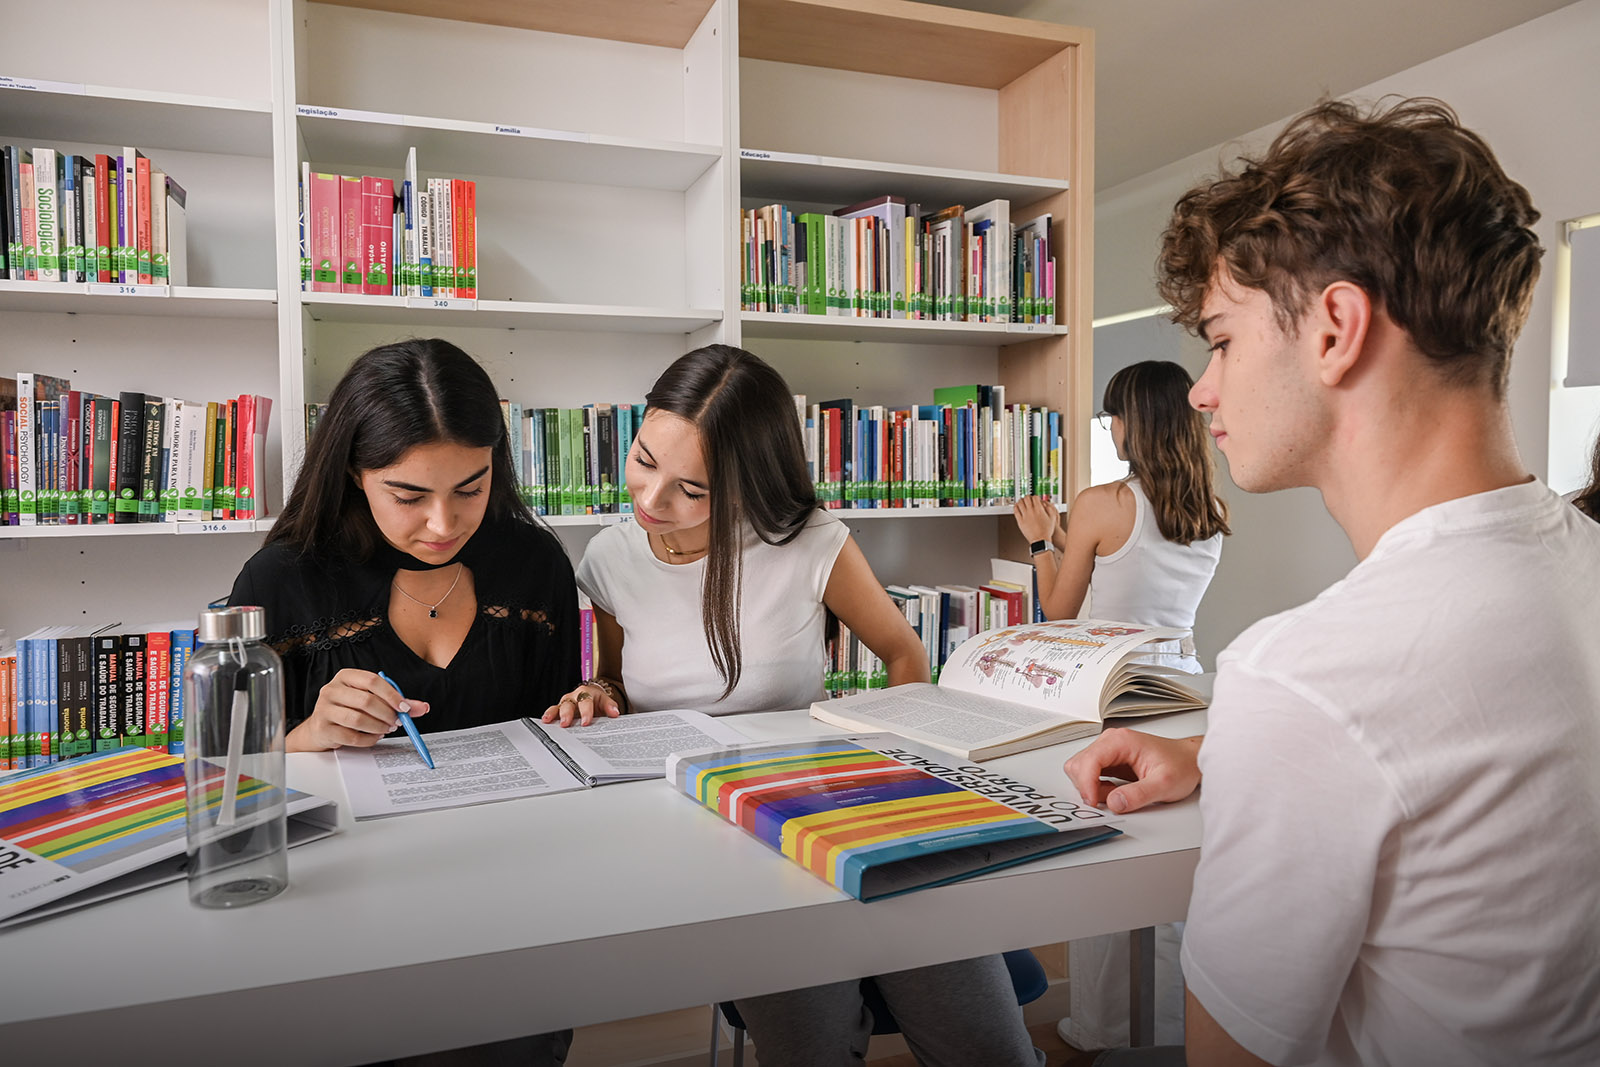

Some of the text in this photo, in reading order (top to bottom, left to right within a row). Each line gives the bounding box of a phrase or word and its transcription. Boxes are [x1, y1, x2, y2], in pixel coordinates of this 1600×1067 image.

[741, 151, 770, 159] Educação
[37, 188, 55, 248] Sociologia
[123, 409, 131, 435] LOGIA
[130, 410, 138, 436] PSICO
[20, 397, 29, 484] SOCIAL PSYCHOLOGY
[146, 420, 154, 453] PSICOLOGIA
[172, 416, 181, 458] COLABORAR
[152, 447, 159, 457] EM
[99, 661, 107, 684] SAÚDE
[109, 654, 117, 683] MANUAL
[125, 658, 134, 681] SAÚDE
[135, 651, 143, 680] MANUAL
[149, 657, 158, 680] SAÚDE
[159, 650, 167, 679] MANUAL
[173, 653, 182, 676] SAÚDE
[99, 685, 106, 695] DO
[109, 684, 117, 694] DE
[125, 683, 133, 693] DO
[136, 682, 143, 691] DE
[150, 681, 156, 691] DO
[159, 680, 166, 690] DE
[174, 677, 180, 688] DO
[99, 697, 107, 733] TRABALH
[879, 748, 1073, 825] UNIVERSIDADE
[957, 765, 1105, 820] DO PORTO
